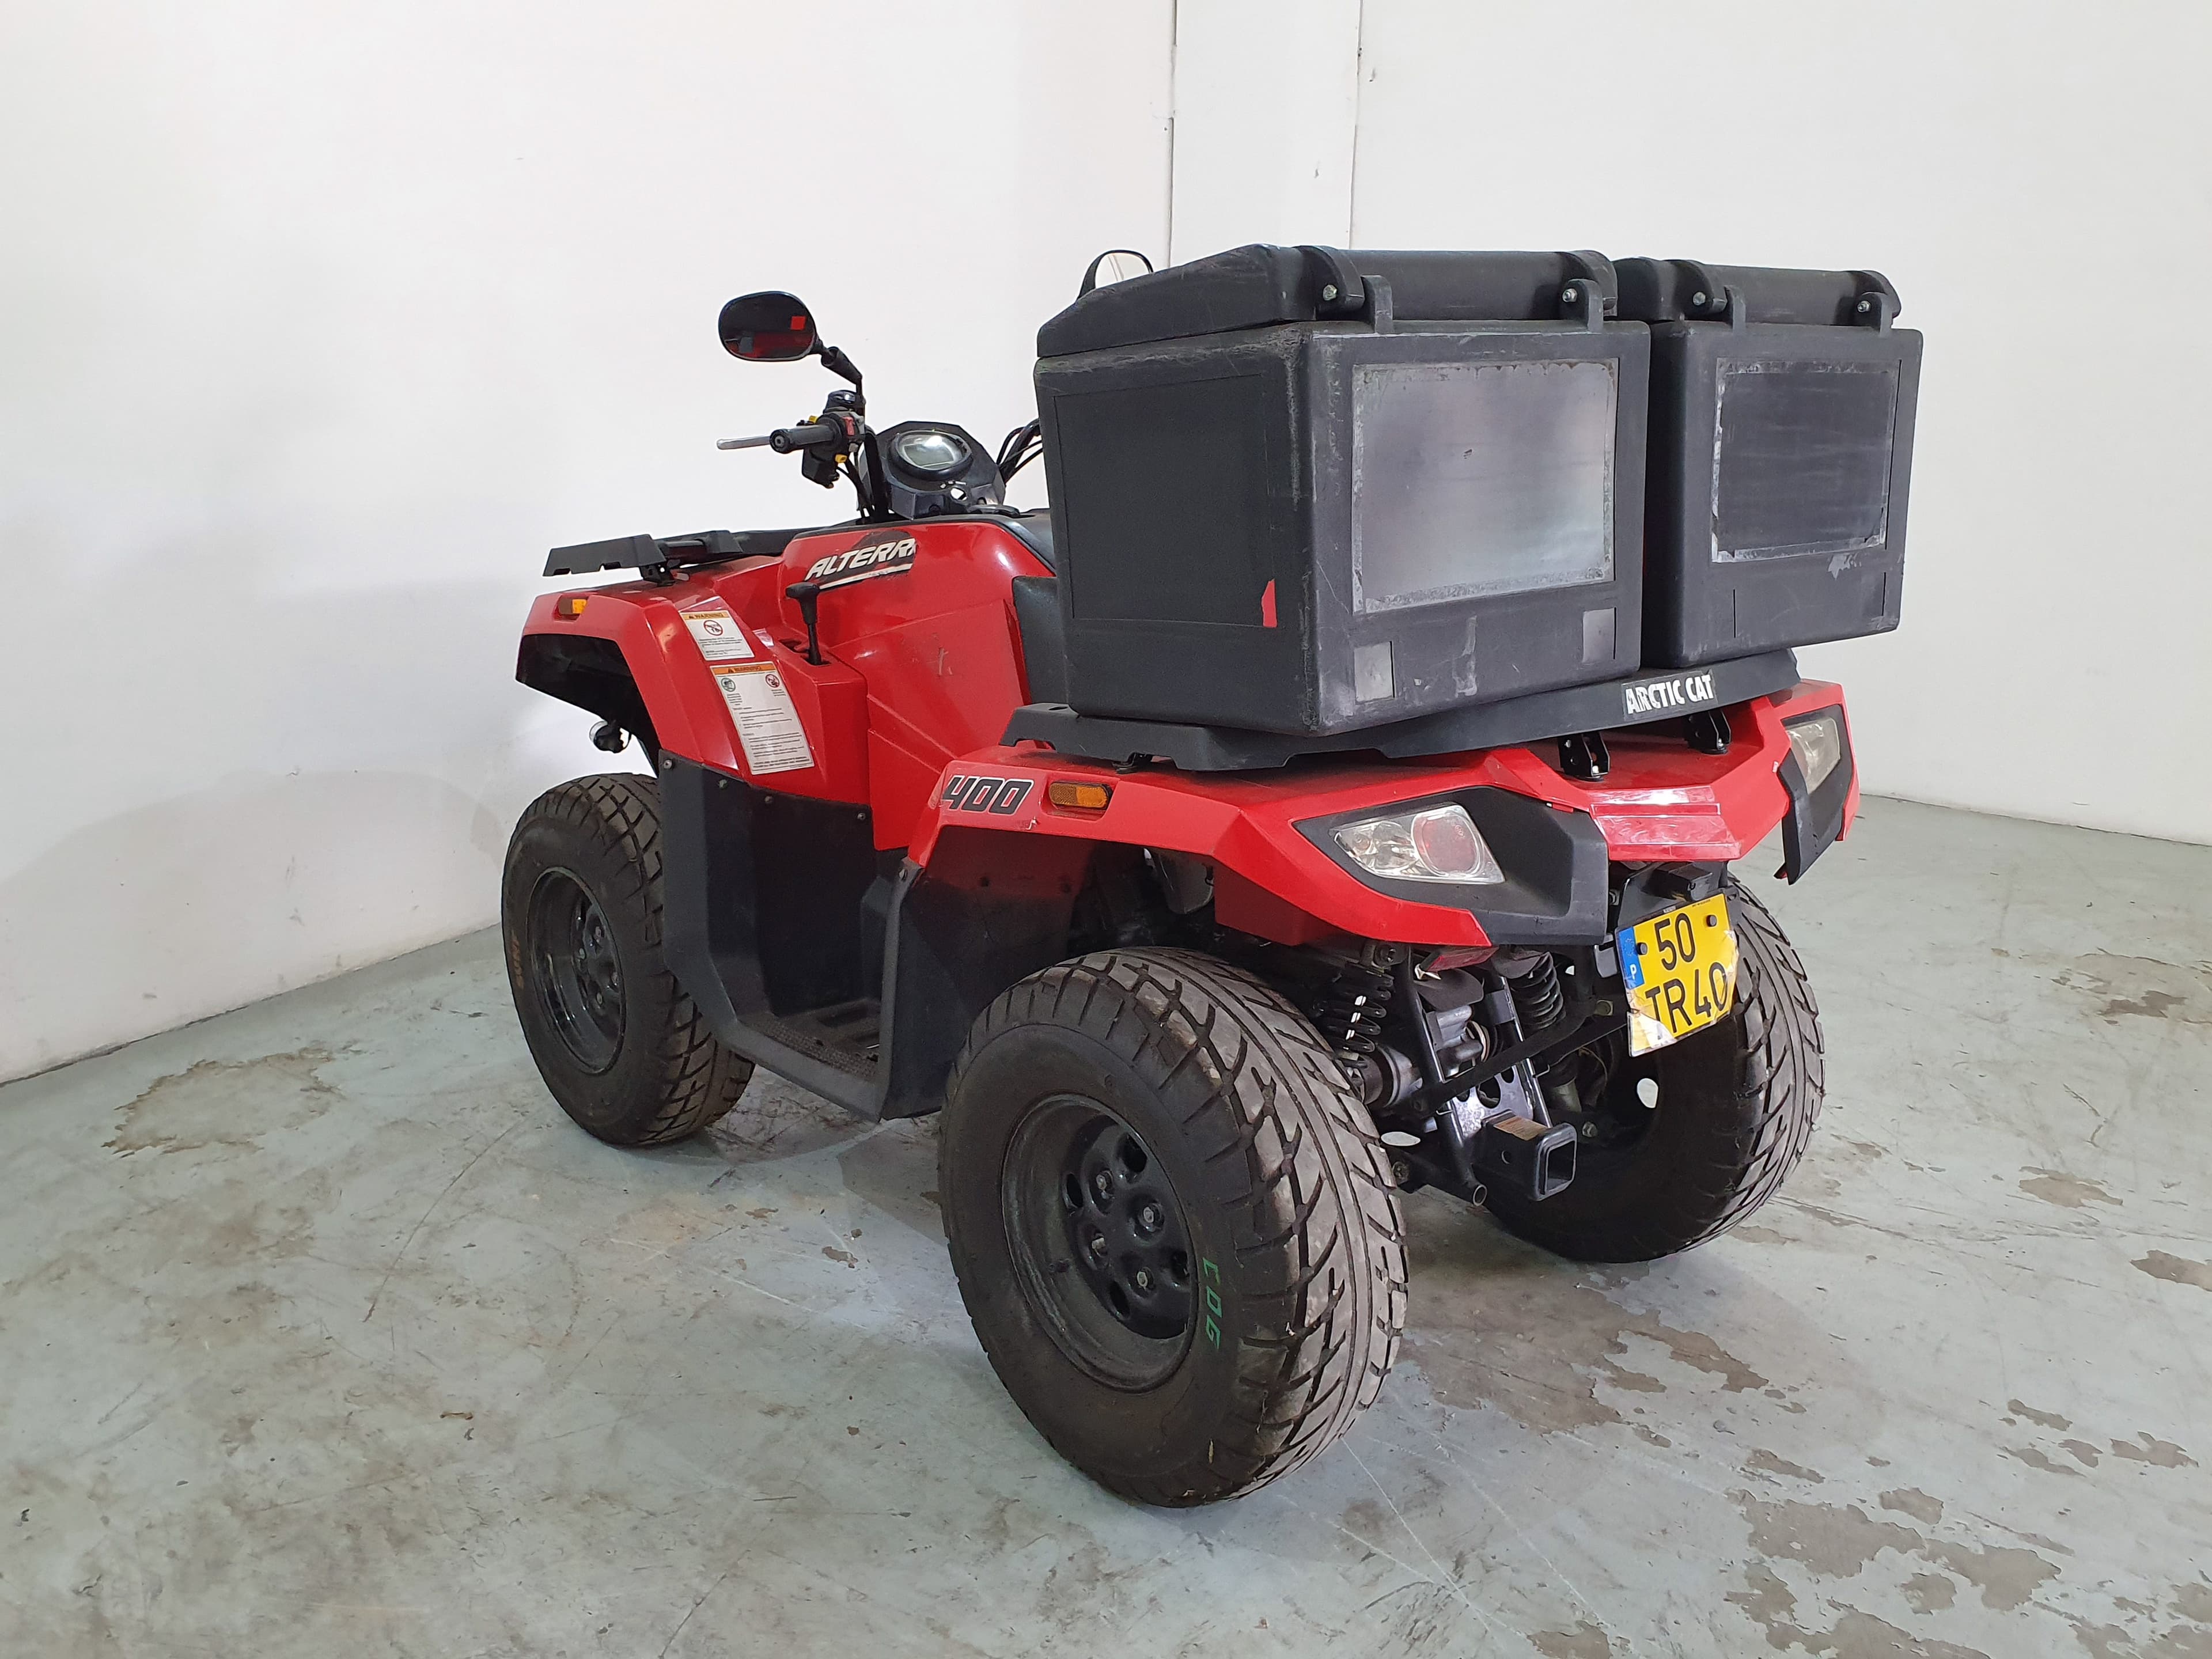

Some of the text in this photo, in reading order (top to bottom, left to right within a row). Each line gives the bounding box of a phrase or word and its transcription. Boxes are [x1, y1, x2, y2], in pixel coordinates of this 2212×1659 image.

[1625, 675, 1714, 714] ARCTIC CAT
[942, 775, 1033, 815] 400
[1654, 912, 1695, 970] 50
[1630, 964, 1637, 979] P
